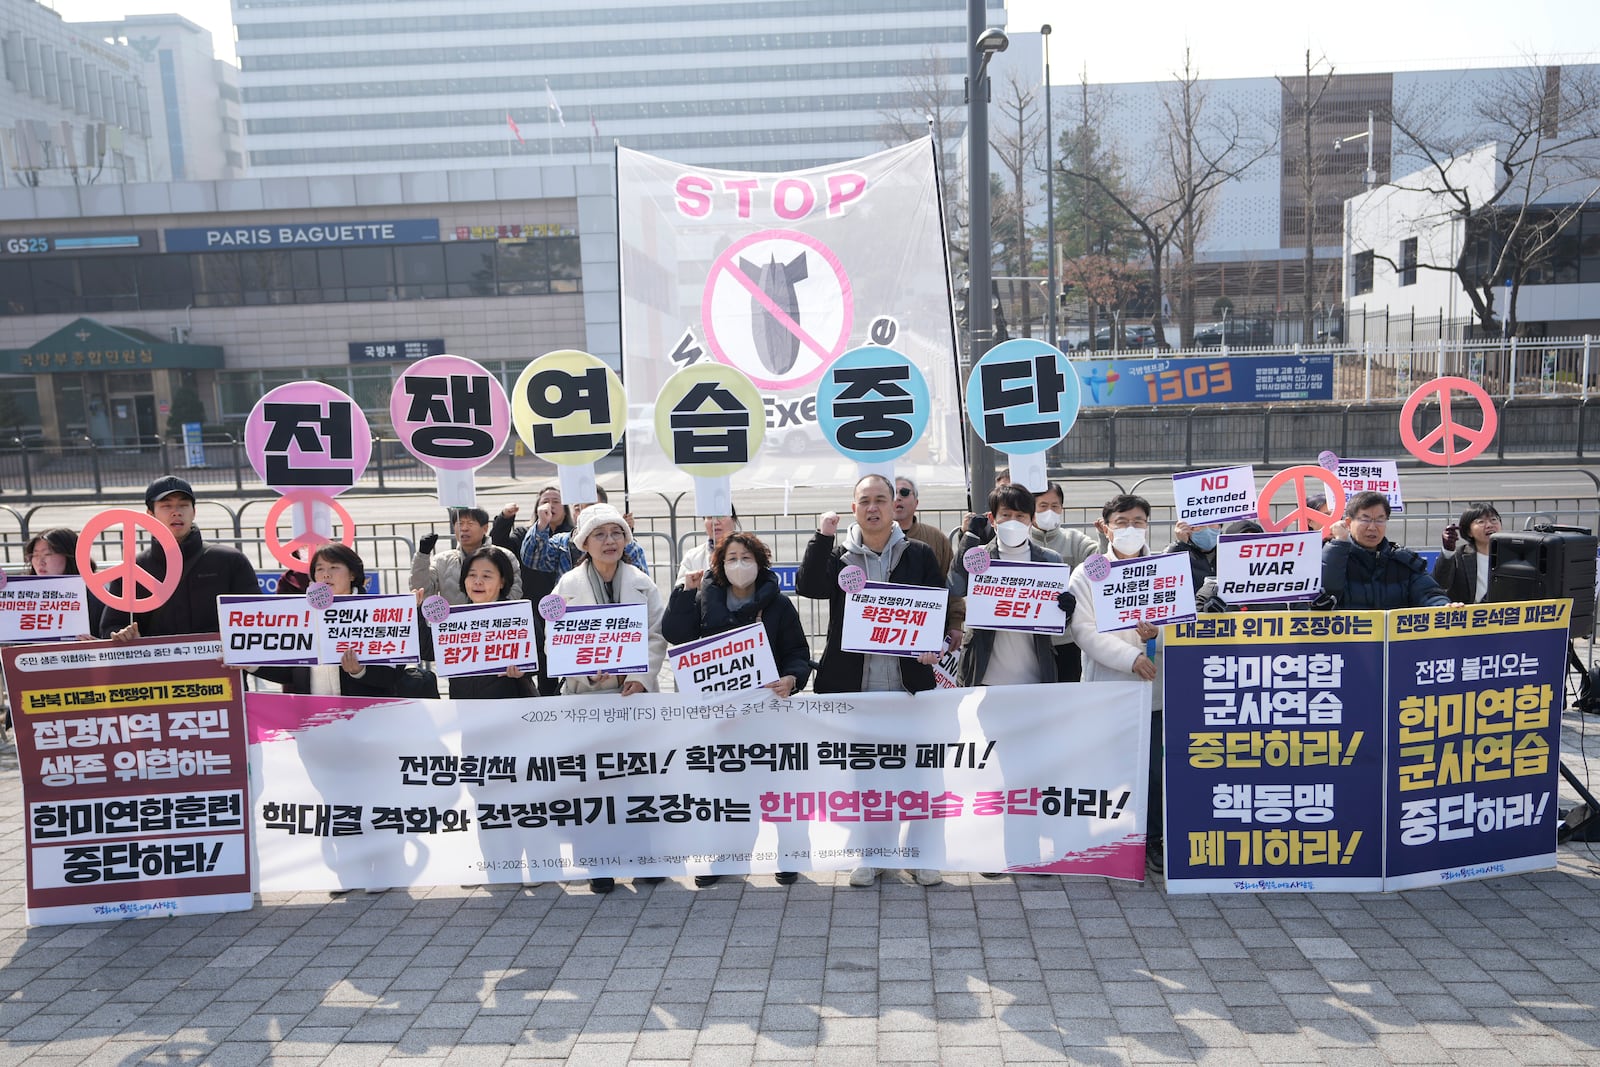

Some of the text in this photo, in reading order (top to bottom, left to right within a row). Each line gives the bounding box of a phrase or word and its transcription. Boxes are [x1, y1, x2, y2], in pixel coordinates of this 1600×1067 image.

[676, 174, 866, 220] STOP
[7, 238, 48, 253] GS25
[207, 224, 395, 246] PARIS BAGUETTE
[364, 345, 397, 358] 국방부
[1144, 362, 1233, 404] 1303
[526, 367, 613, 454] 연
[832, 365, 914, 452] 중
[980, 354, 1065, 446] 단
[404, 375, 494, 459] 쟁
[670, 382, 750, 465] 습
[263, 401, 353, 486] 전
[1200, 475, 1229, 491] NO
[1338, 466, 1382, 478] 전쟁획책
[1341, 480, 1364, 491] 석열
[1187, 490, 1246, 506] Extended
[1122, 564, 1158, 579] 한미일
[1249, 561, 1295, 576] WAR
[972, 584, 1060, 602] 한미연합 군사연습
[974, 574, 1065, 590] 대결과 전쟁위기 불러오는
[1103, 579, 1150, 596] 군사훈련
[40, 601, 81, 611] 군사연습
[851, 593, 943, 610] 대결과 전쟁위기 불러오는
[1114, 590, 1177, 609] 한미일 동맹
[323, 609, 368, 624] 유엔사
[438, 617, 528, 632] 유엔사 전력 제공국의
[553, 617, 643, 632] 주민생존 위협하는
[861, 605, 928, 627] 확장억제
[1118, 609, 1141, 623] 구축
[1175, 615, 1373, 638] 대결과 위기 조장하는
[1396, 603, 1566, 634] 전쟁 획책 윤석열 파면!
[230, 633, 313, 651] OPCON
[327, 626, 411, 639] 전시작전통제권
[438, 628, 529, 645] 한미연합 군사연습
[552, 631, 642, 646] 한미연합 군사연습
[20, 656, 38, 666] 주민
[40, 656, 58, 665] 생존
[60, 654, 97, 664] 위협하는
[99, 650, 152, 661] 한미연합연습
[153, 648, 171, 657] 중단
[173, 647, 190, 656] 촉구
[335, 641, 364, 655] 즉각
[444, 645, 479, 665] 참가
[693, 653, 755, 684] OPLAN
[1203, 653, 1344, 690] 한미연합
[1415, 652, 1540, 686] 전쟁 불러오는
[30, 684, 224, 708] 남북 대결과 전쟁위기 조장하며
[521, 710, 558, 723] <2025
[660, 703, 737, 721] 한미연합연습
[741, 703, 764, 716] 중단
[768, 700, 794, 713] 촉구
[797, 700, 855, 714] 기자회견>
[1203, 690, 1344, 725] 군사연습
[1398, 683, 1554, 745] 한미연합
[32, 709, 230, 750] 접경지역 주민
[1188, 729, 1365, 768] 중단하라!
[40, 748, 231, 787] 생존 위협하는
[398, 740, 997, 787] 전쟁획책 세력 단죄! 확장억제 핵동맹 폐기!
[1398, 732, 1550, 792] 군사연습
[262, 786, 1131, 837] 핵대결 격화와 전쟁위기 조장하는 한미연합연습 중단하라!
[1212, 783, 1335, 823] 핵동맹
[33, 793, 241, 839] 한미연합훈련
[1400, 791, 1551, 846] 중단하라!
[579, 857, 599, 867] 오전
[601, 855, 621, 866] 11시
[664, 855, 689, 864] 국방부
[818, 846, 921, 859] 평화와통일을여는사람들
[1188, 828, 1364, 867] 폐기하라!
[63, 842, 224, 884] 중단하라!
